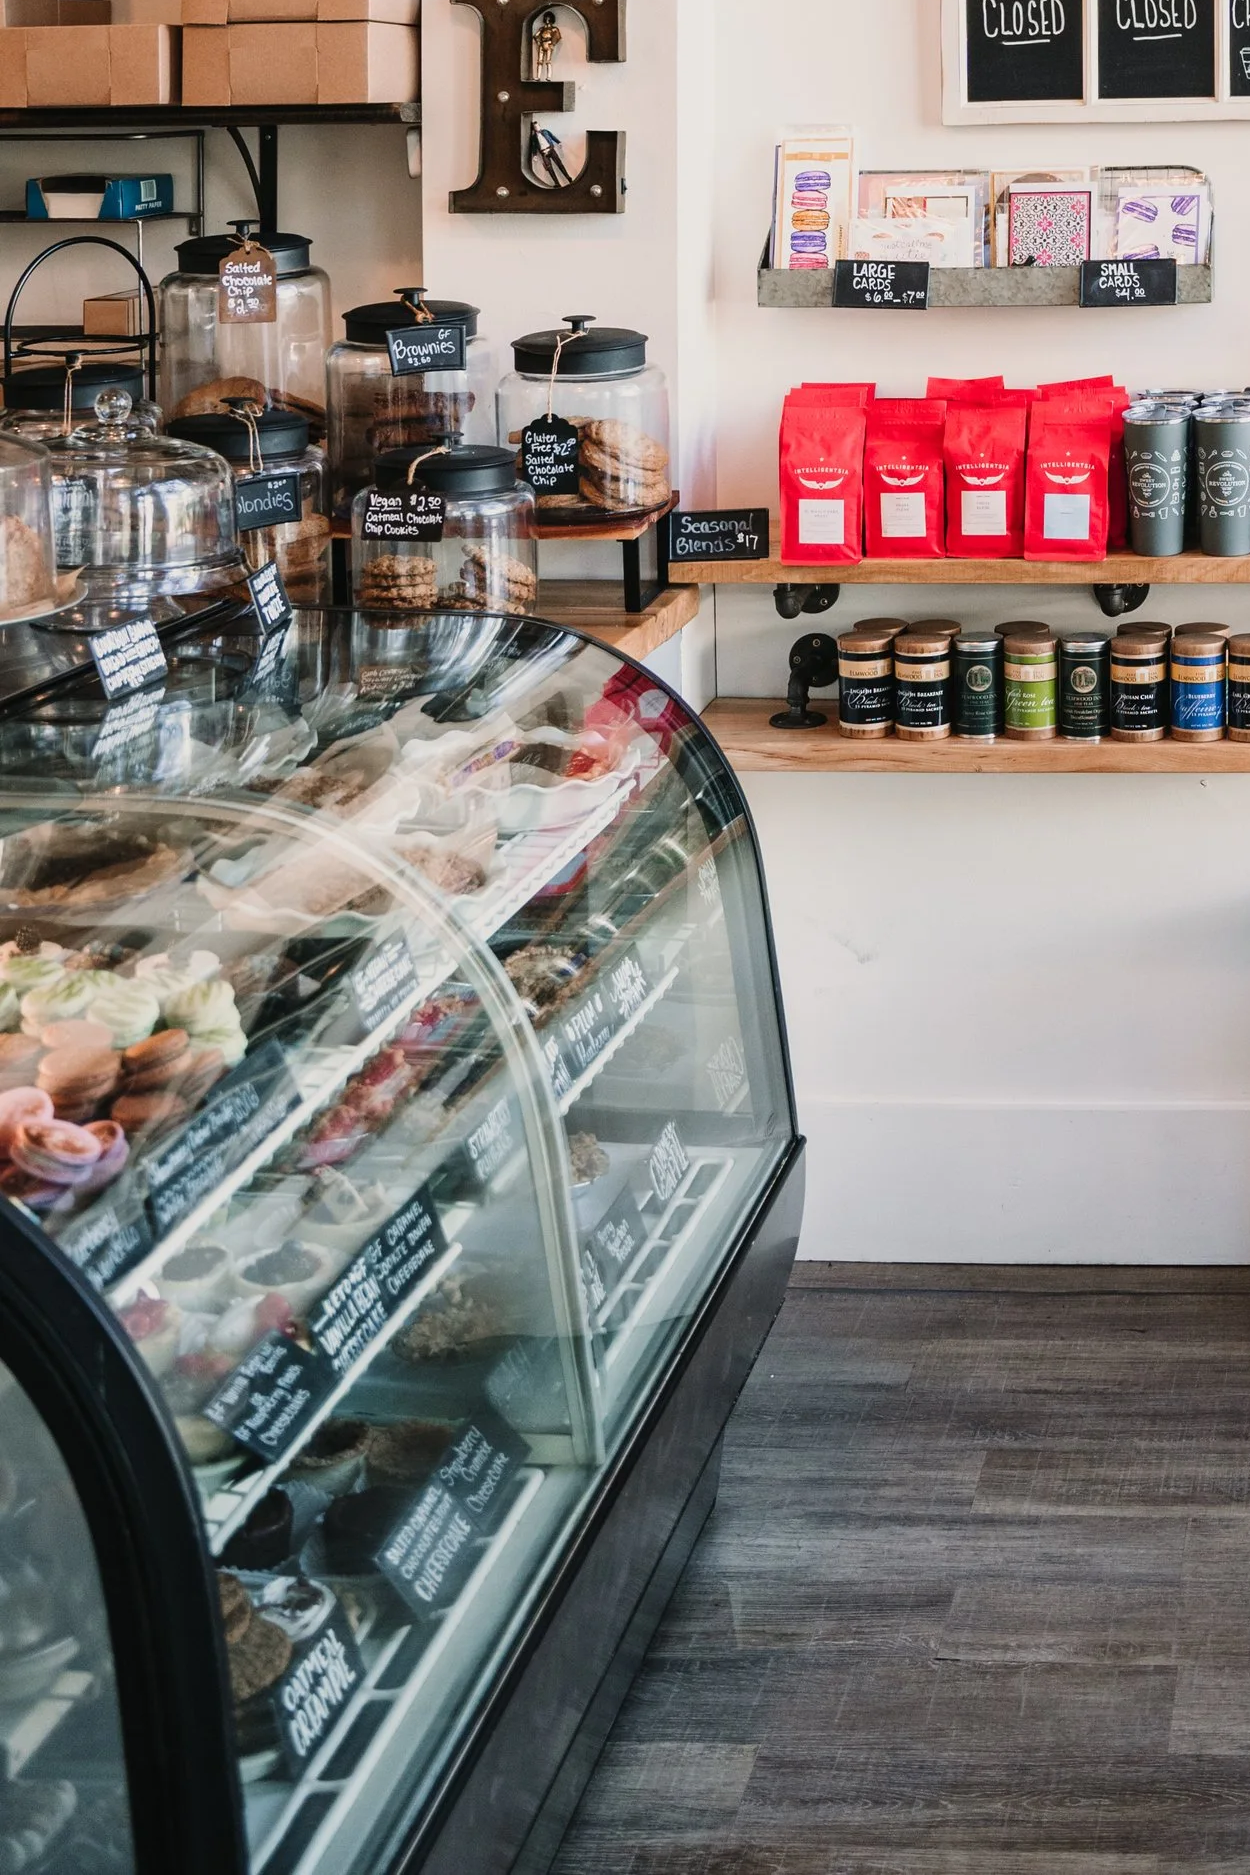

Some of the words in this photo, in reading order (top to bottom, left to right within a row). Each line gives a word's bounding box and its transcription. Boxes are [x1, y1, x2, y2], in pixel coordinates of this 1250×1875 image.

[225, 260, 261, 274] Salted
[853, 262, 896, 279] LARGE
[1100, 262, 1138, 276] SMALL
[221, 273, 273, 287] Chocolate
[852, 277, 891, 291] CARDS
[1099, 275, 1140, 288] CARDS
[227, 285, 254, 297] Chip
[437, 328, 452, 340] GF
[392, 339, 456, 360] Brownies
[525, 431, 557, 444] Gluten
[531, 442, 552, 453] Free
[525, 452, 555, 465] Salted
[528, 463, 575, 475] Chocolate
[532, 475, 557, 487] Chip
[369, 493, 402, 511] Vegan
[366, 511, 404, 522] Oatmeal
[680, 512, 754, 535] Seasonal
[365, 522, 383, 535] Chip
[384, 523, 419, 536] Cookies
[675, 536, 735, 555] Blends
[736, 532, 759, 550] $17
[385, 1200, 424, 1247] CARAMEL
